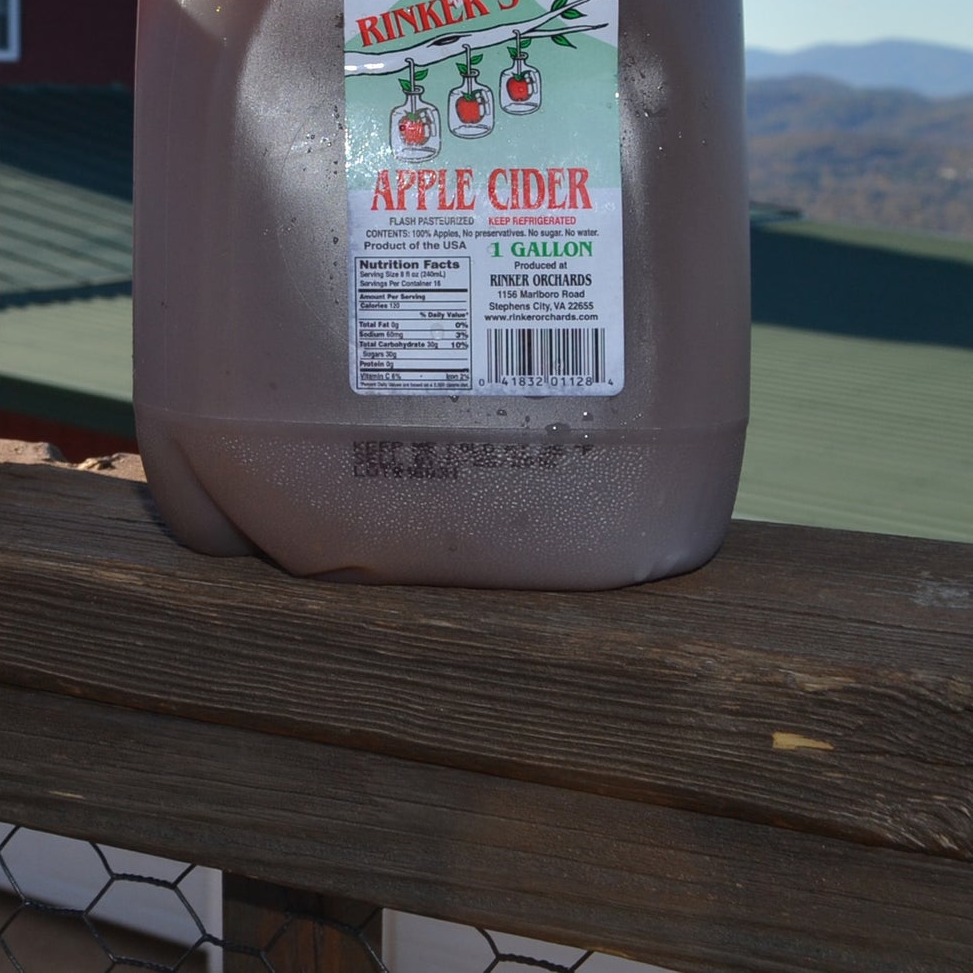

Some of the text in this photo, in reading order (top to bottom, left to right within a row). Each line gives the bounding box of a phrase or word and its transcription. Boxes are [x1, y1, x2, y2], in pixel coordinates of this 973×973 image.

[370, 167, 593, 211] APPLE CIDER
[389, 216, 475, 226] FLASH PASTEURIZED
[488, 216, 577, 226] KEEP REFRIGERATED
[365, 229, 599, 239] CONTENTS: 100% Apples, No preservatives. No sugar. No water.
[364, 241, 467, 250] Product of the USA
[490, 241, 593, 257] 1 GALLON
[359, 259, 460, 269] Nutrition Facts
[514, 261, 568, 270] Produced at
[359, 280, 388, 288] Servings
[490, 274, 593, 287] RINKER ORCHARDS
[400, 293, 426, 301] Serving
[498, 290, 585, 299] 1156 Marlboro Road
[489, 301, 594, 312] Stephens City, VA 22655
[484, 313, 599, 321] www.rinkerorchards.com
[378, 341, 425, 349] Carbohydrate
[478, 378, 485, 387] 0
[501, 377, 543, 387] 41832
[550, 377, 593, 387] 01128
